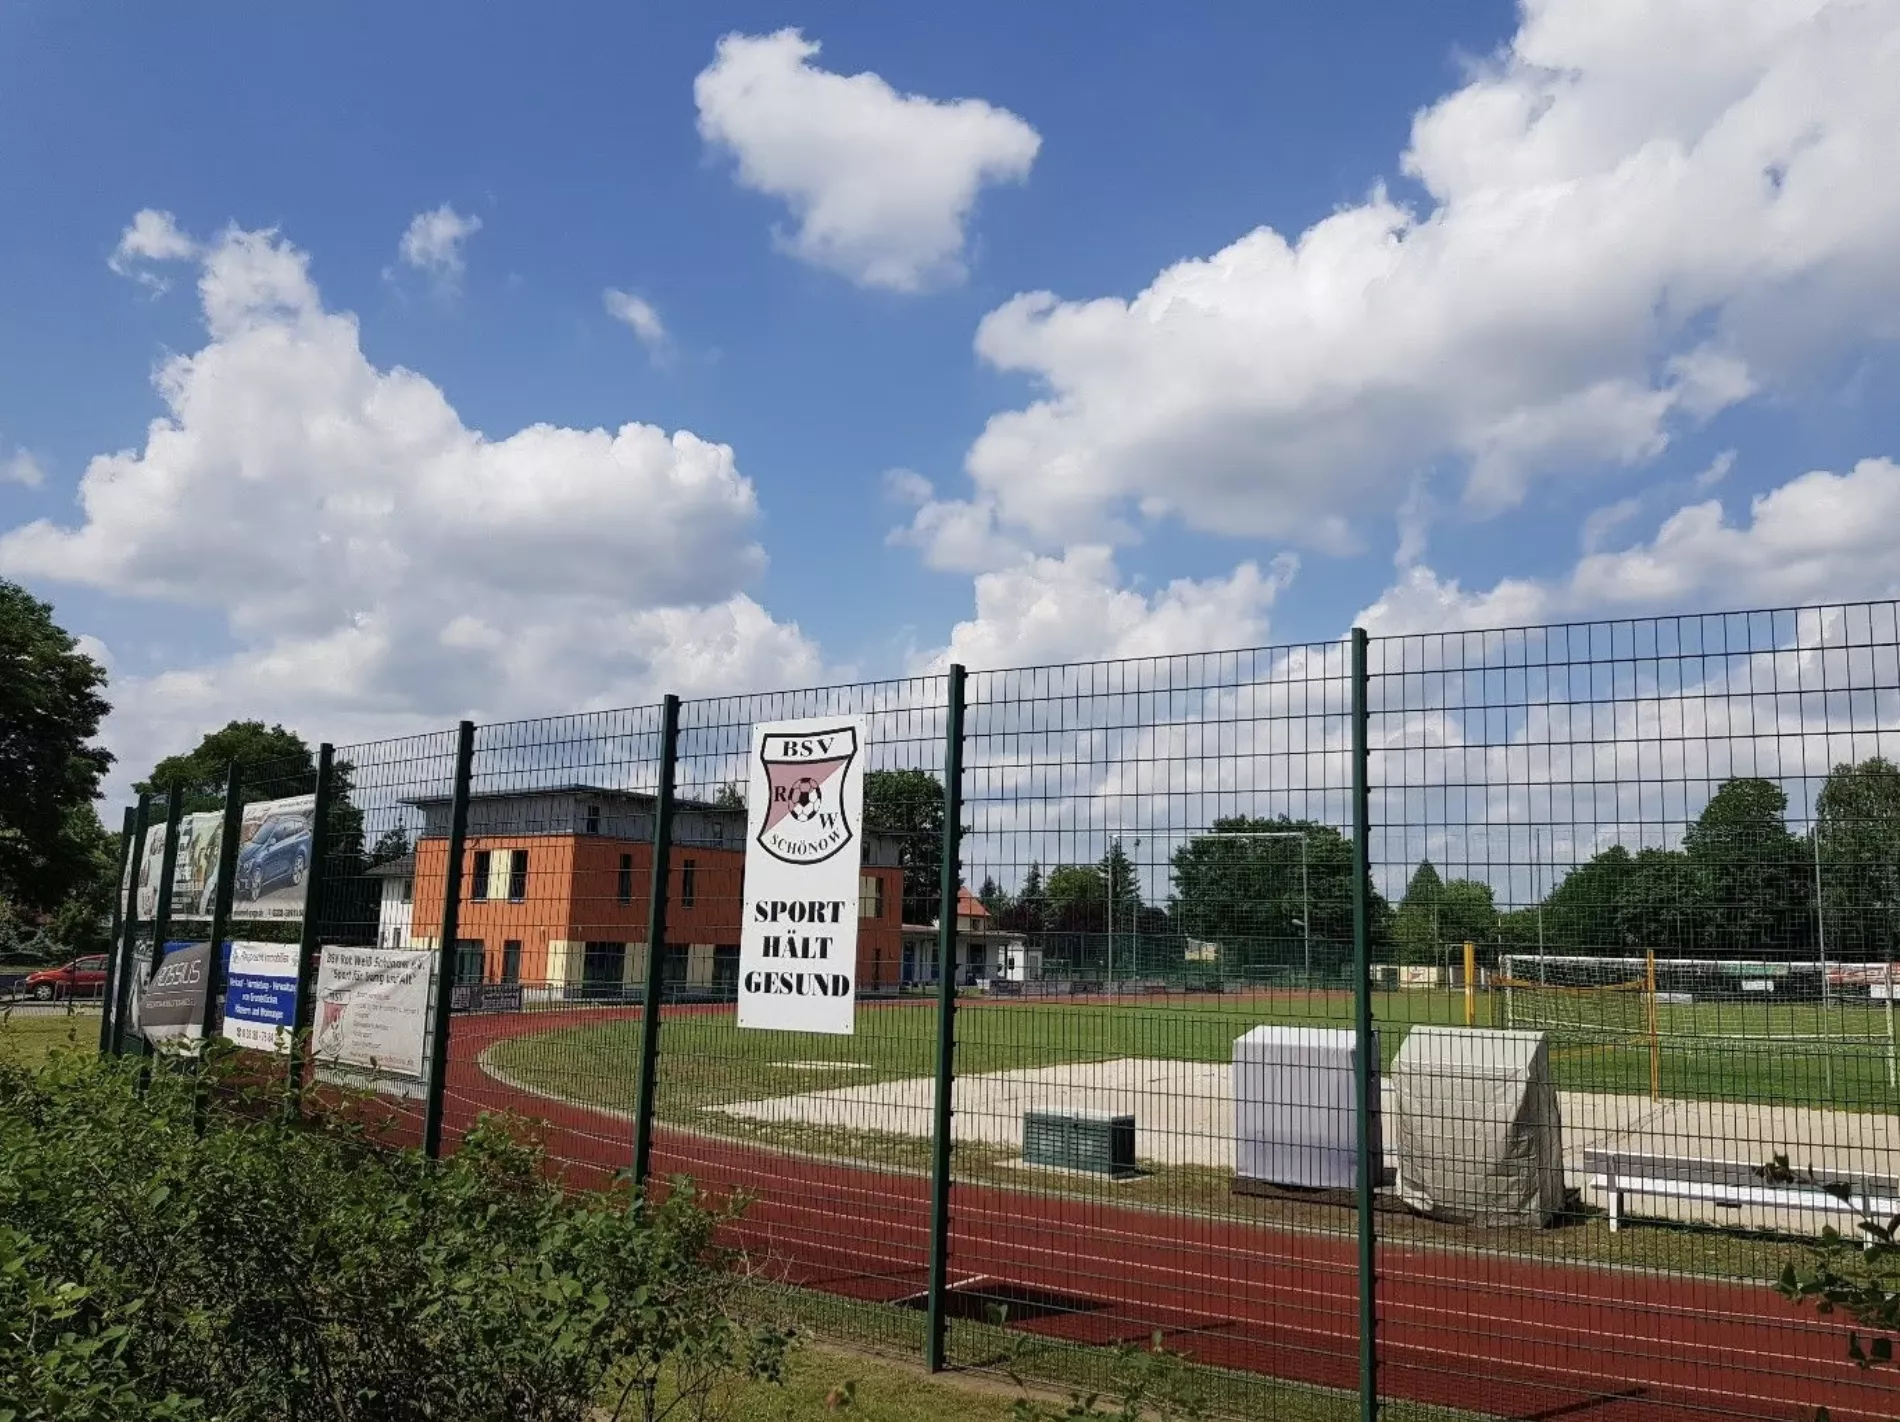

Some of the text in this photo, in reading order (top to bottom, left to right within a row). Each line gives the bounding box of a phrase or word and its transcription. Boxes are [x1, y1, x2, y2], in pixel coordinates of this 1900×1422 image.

[782, 737, 834, 757] BSV
[774, 786, 786, 802] R
[820, 812, 838, 830] W
[770, 828, 841, 855] SCHÖNOW
[754, 900, 845, 923] SPORT
[762, 929, 833, 959] HÄLT
[744, 971, 850, 997] GESUND
